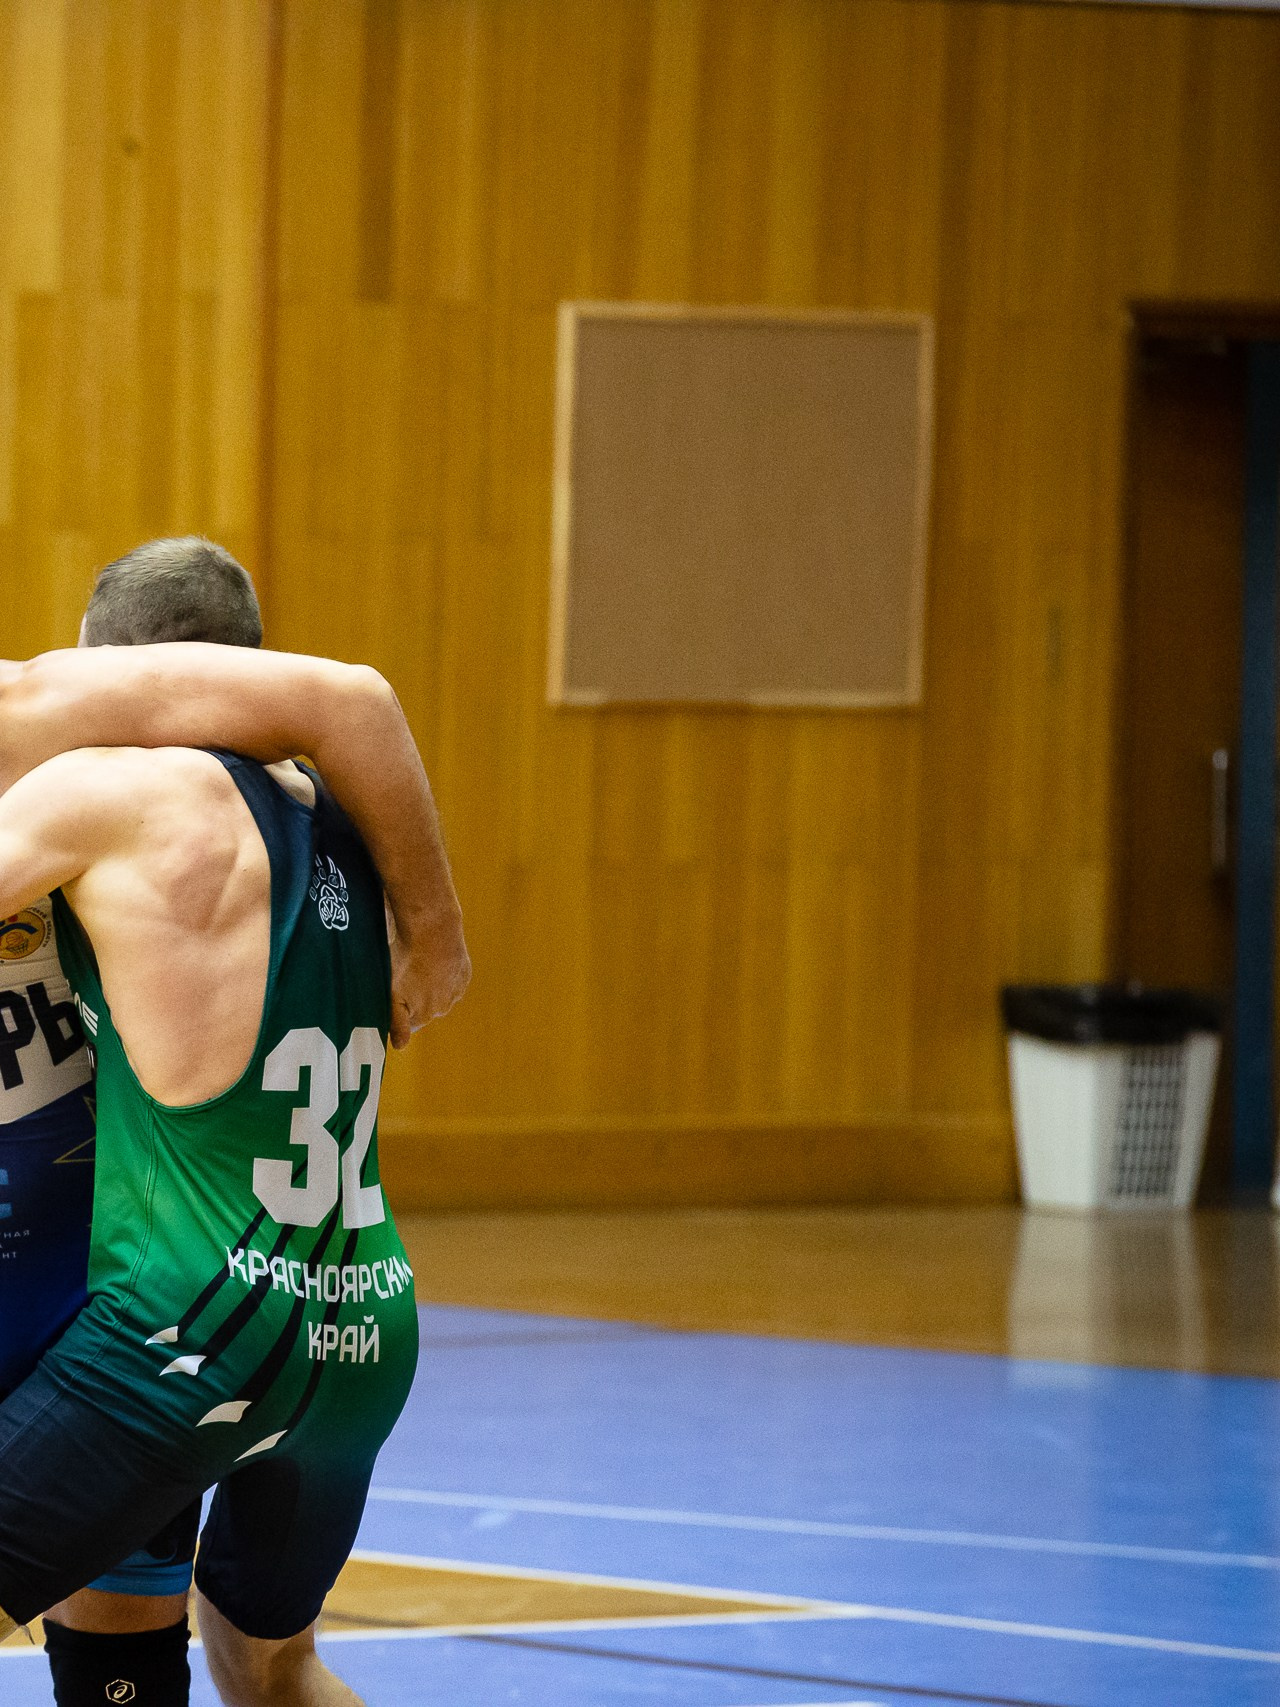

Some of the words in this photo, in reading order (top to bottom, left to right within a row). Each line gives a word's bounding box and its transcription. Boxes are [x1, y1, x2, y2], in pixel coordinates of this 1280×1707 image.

[252, 1027, 385, 1229] 32
[225, 1246, 413, 1303] КРАСНОЯРСКИ
[307, 1314, 380, 1364] КРАЙ
